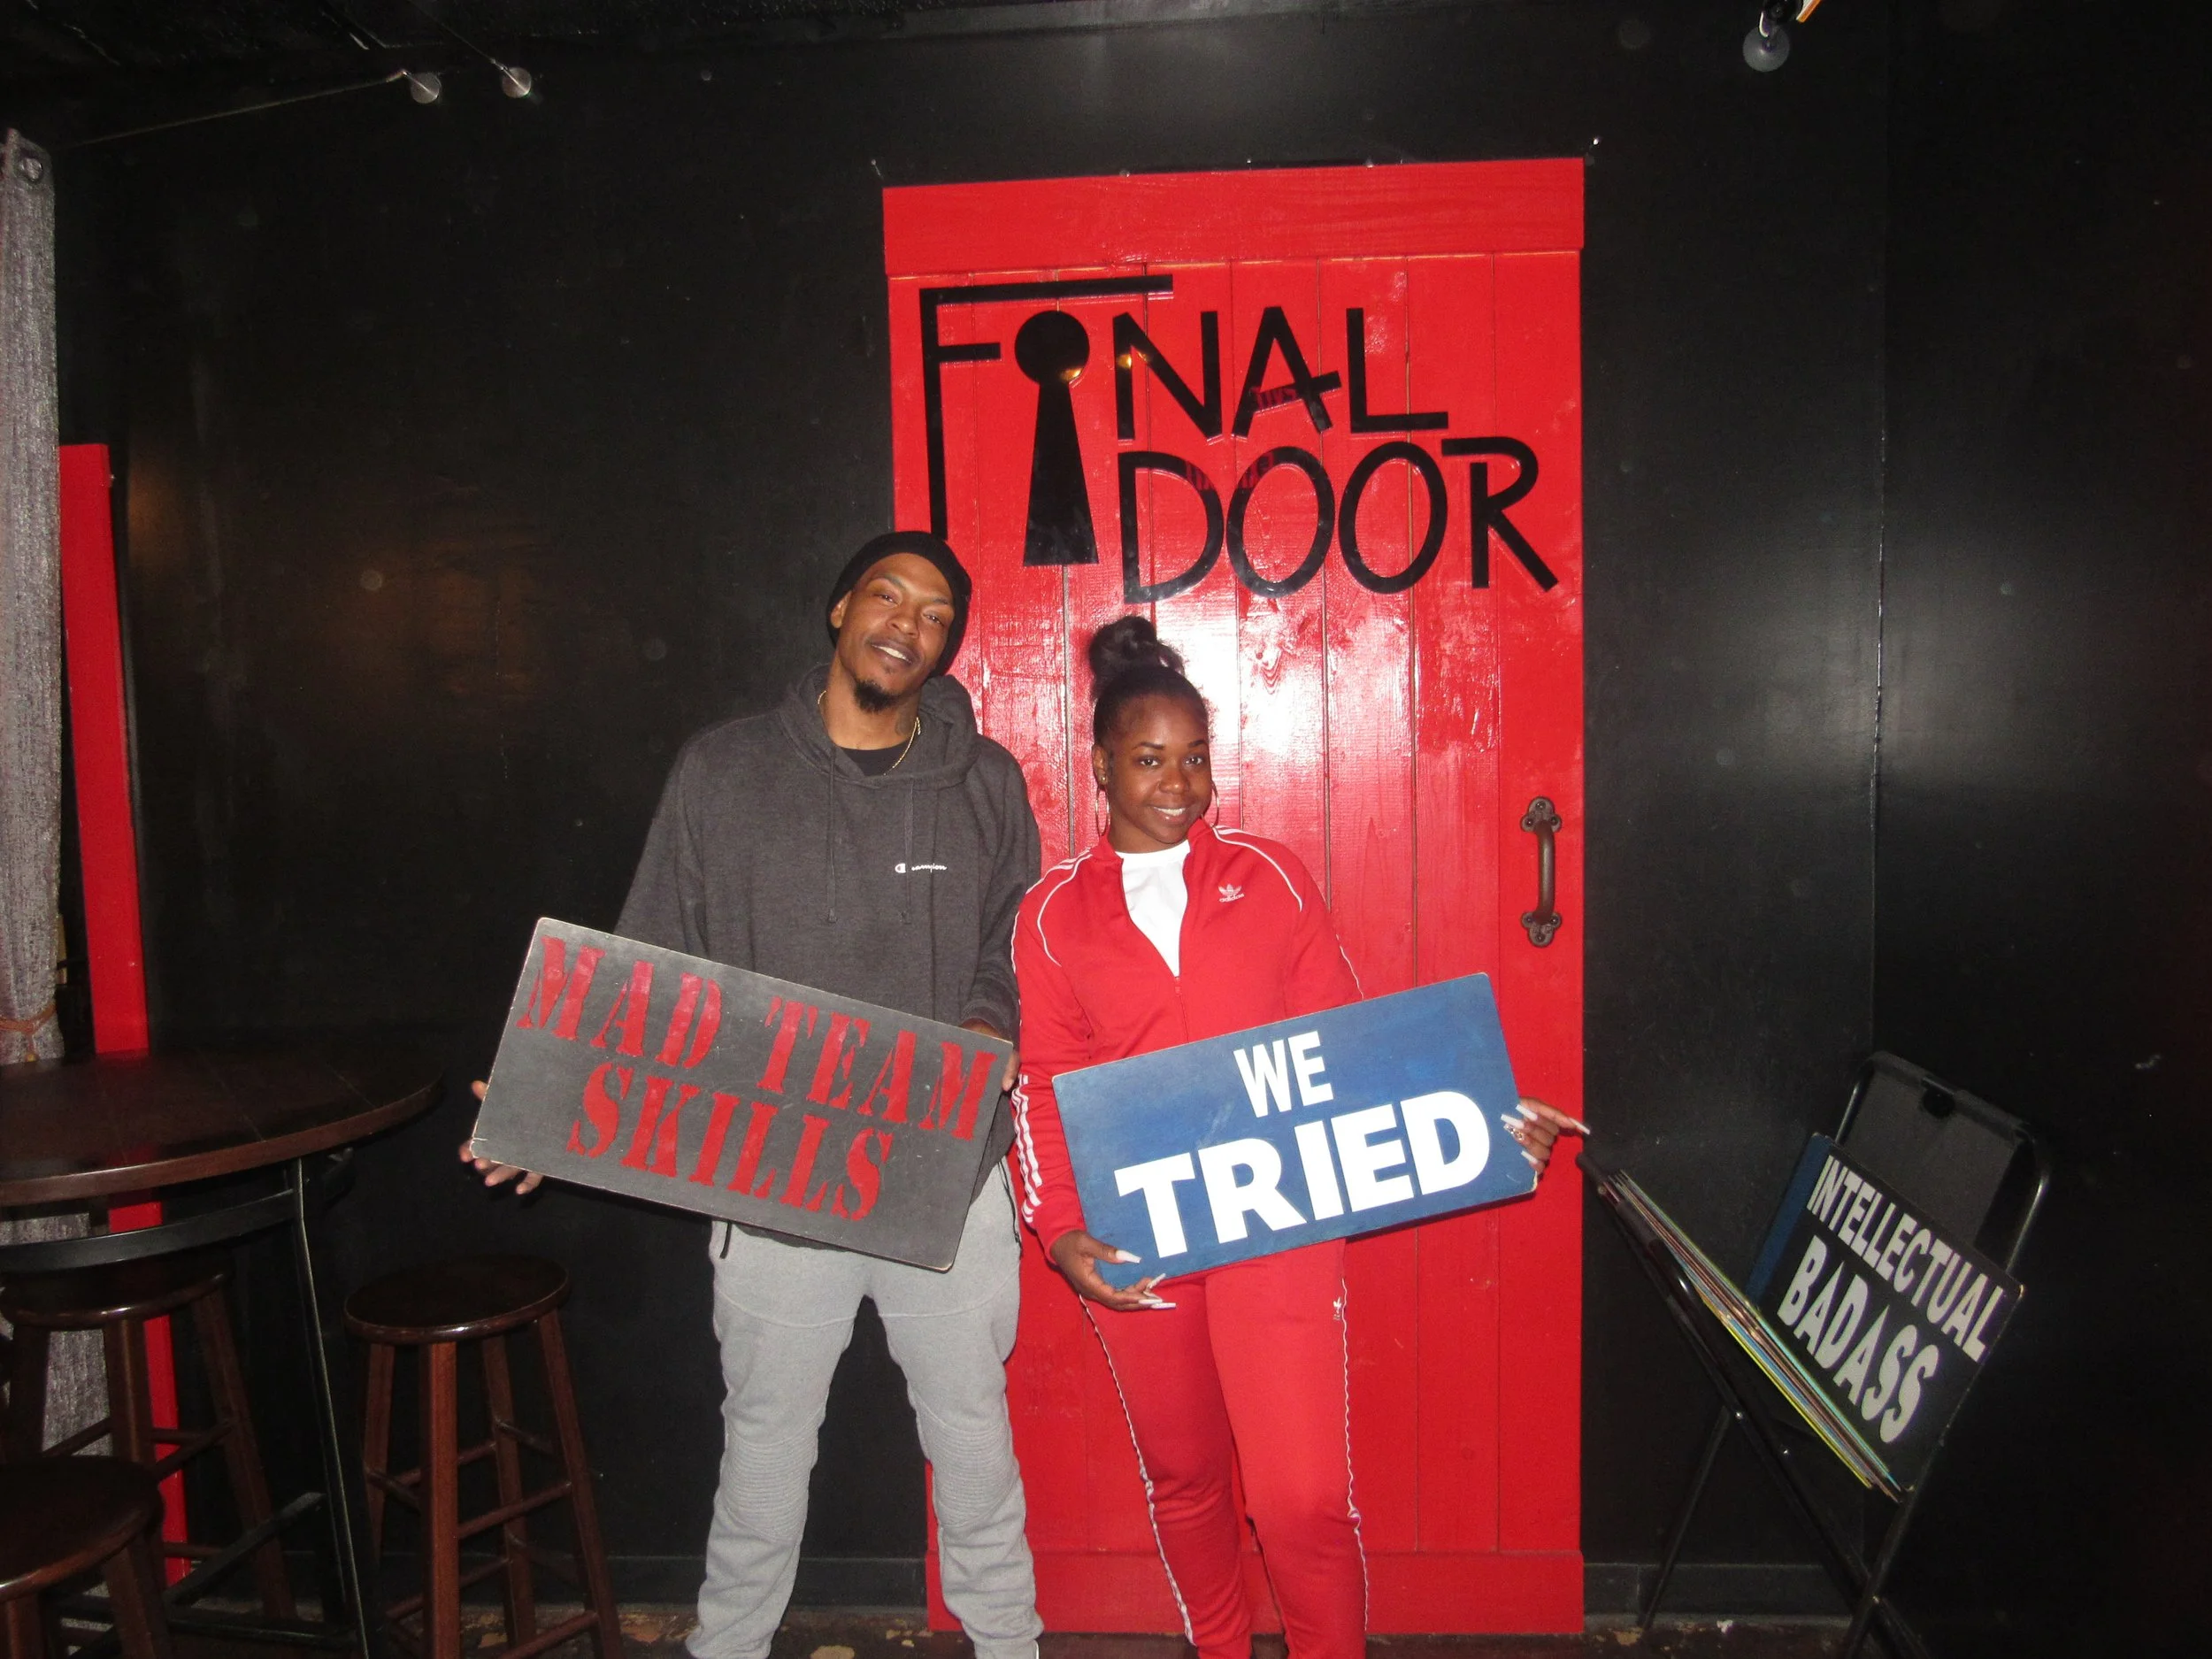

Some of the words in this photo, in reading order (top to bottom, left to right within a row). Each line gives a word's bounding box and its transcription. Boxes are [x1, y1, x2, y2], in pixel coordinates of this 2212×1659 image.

[1118, 436, 1558, 603] DOOR
[1218, 893, 1245, 902] adidas
[515, 935, 722, 1069] MAD
[757, 995, 998, 1141] TEAM
[1233, 1030, 1333, 1118] WE
[565, 1062, 894, 1221] SKILLS
[1113, 1091, 1491, 1259] TRIED
[1777, 1234, 1939, 1443] BADASS
[1806, 1154, 2006, 1363] INTELLECTUAL
